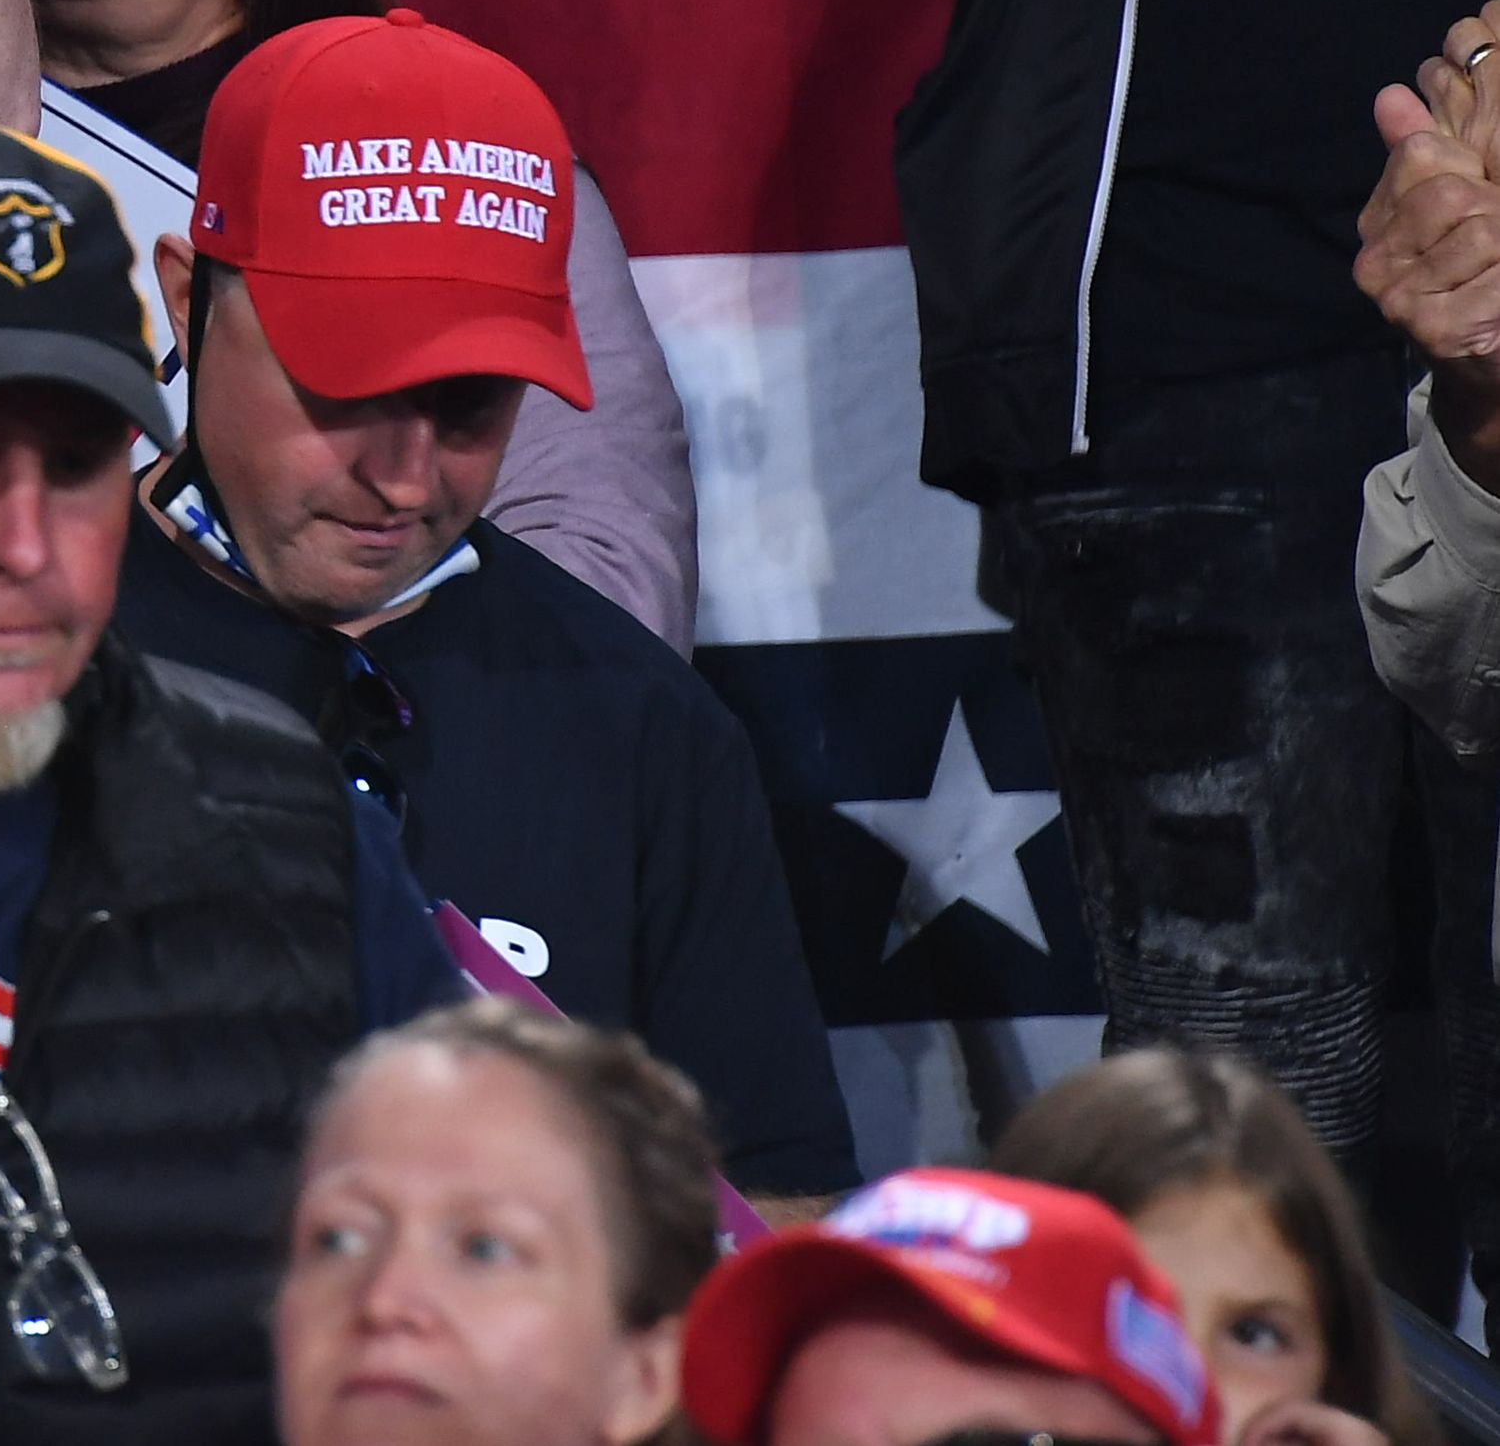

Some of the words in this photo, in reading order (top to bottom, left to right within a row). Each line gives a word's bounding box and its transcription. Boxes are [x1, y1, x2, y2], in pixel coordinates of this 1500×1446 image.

[301, 139, 413, 180] MAKE
[417, 138, 556, 197] AMERICA
[320, 185, 446, 227] GREAT
[456, 188, 549, 244] AGAIN
